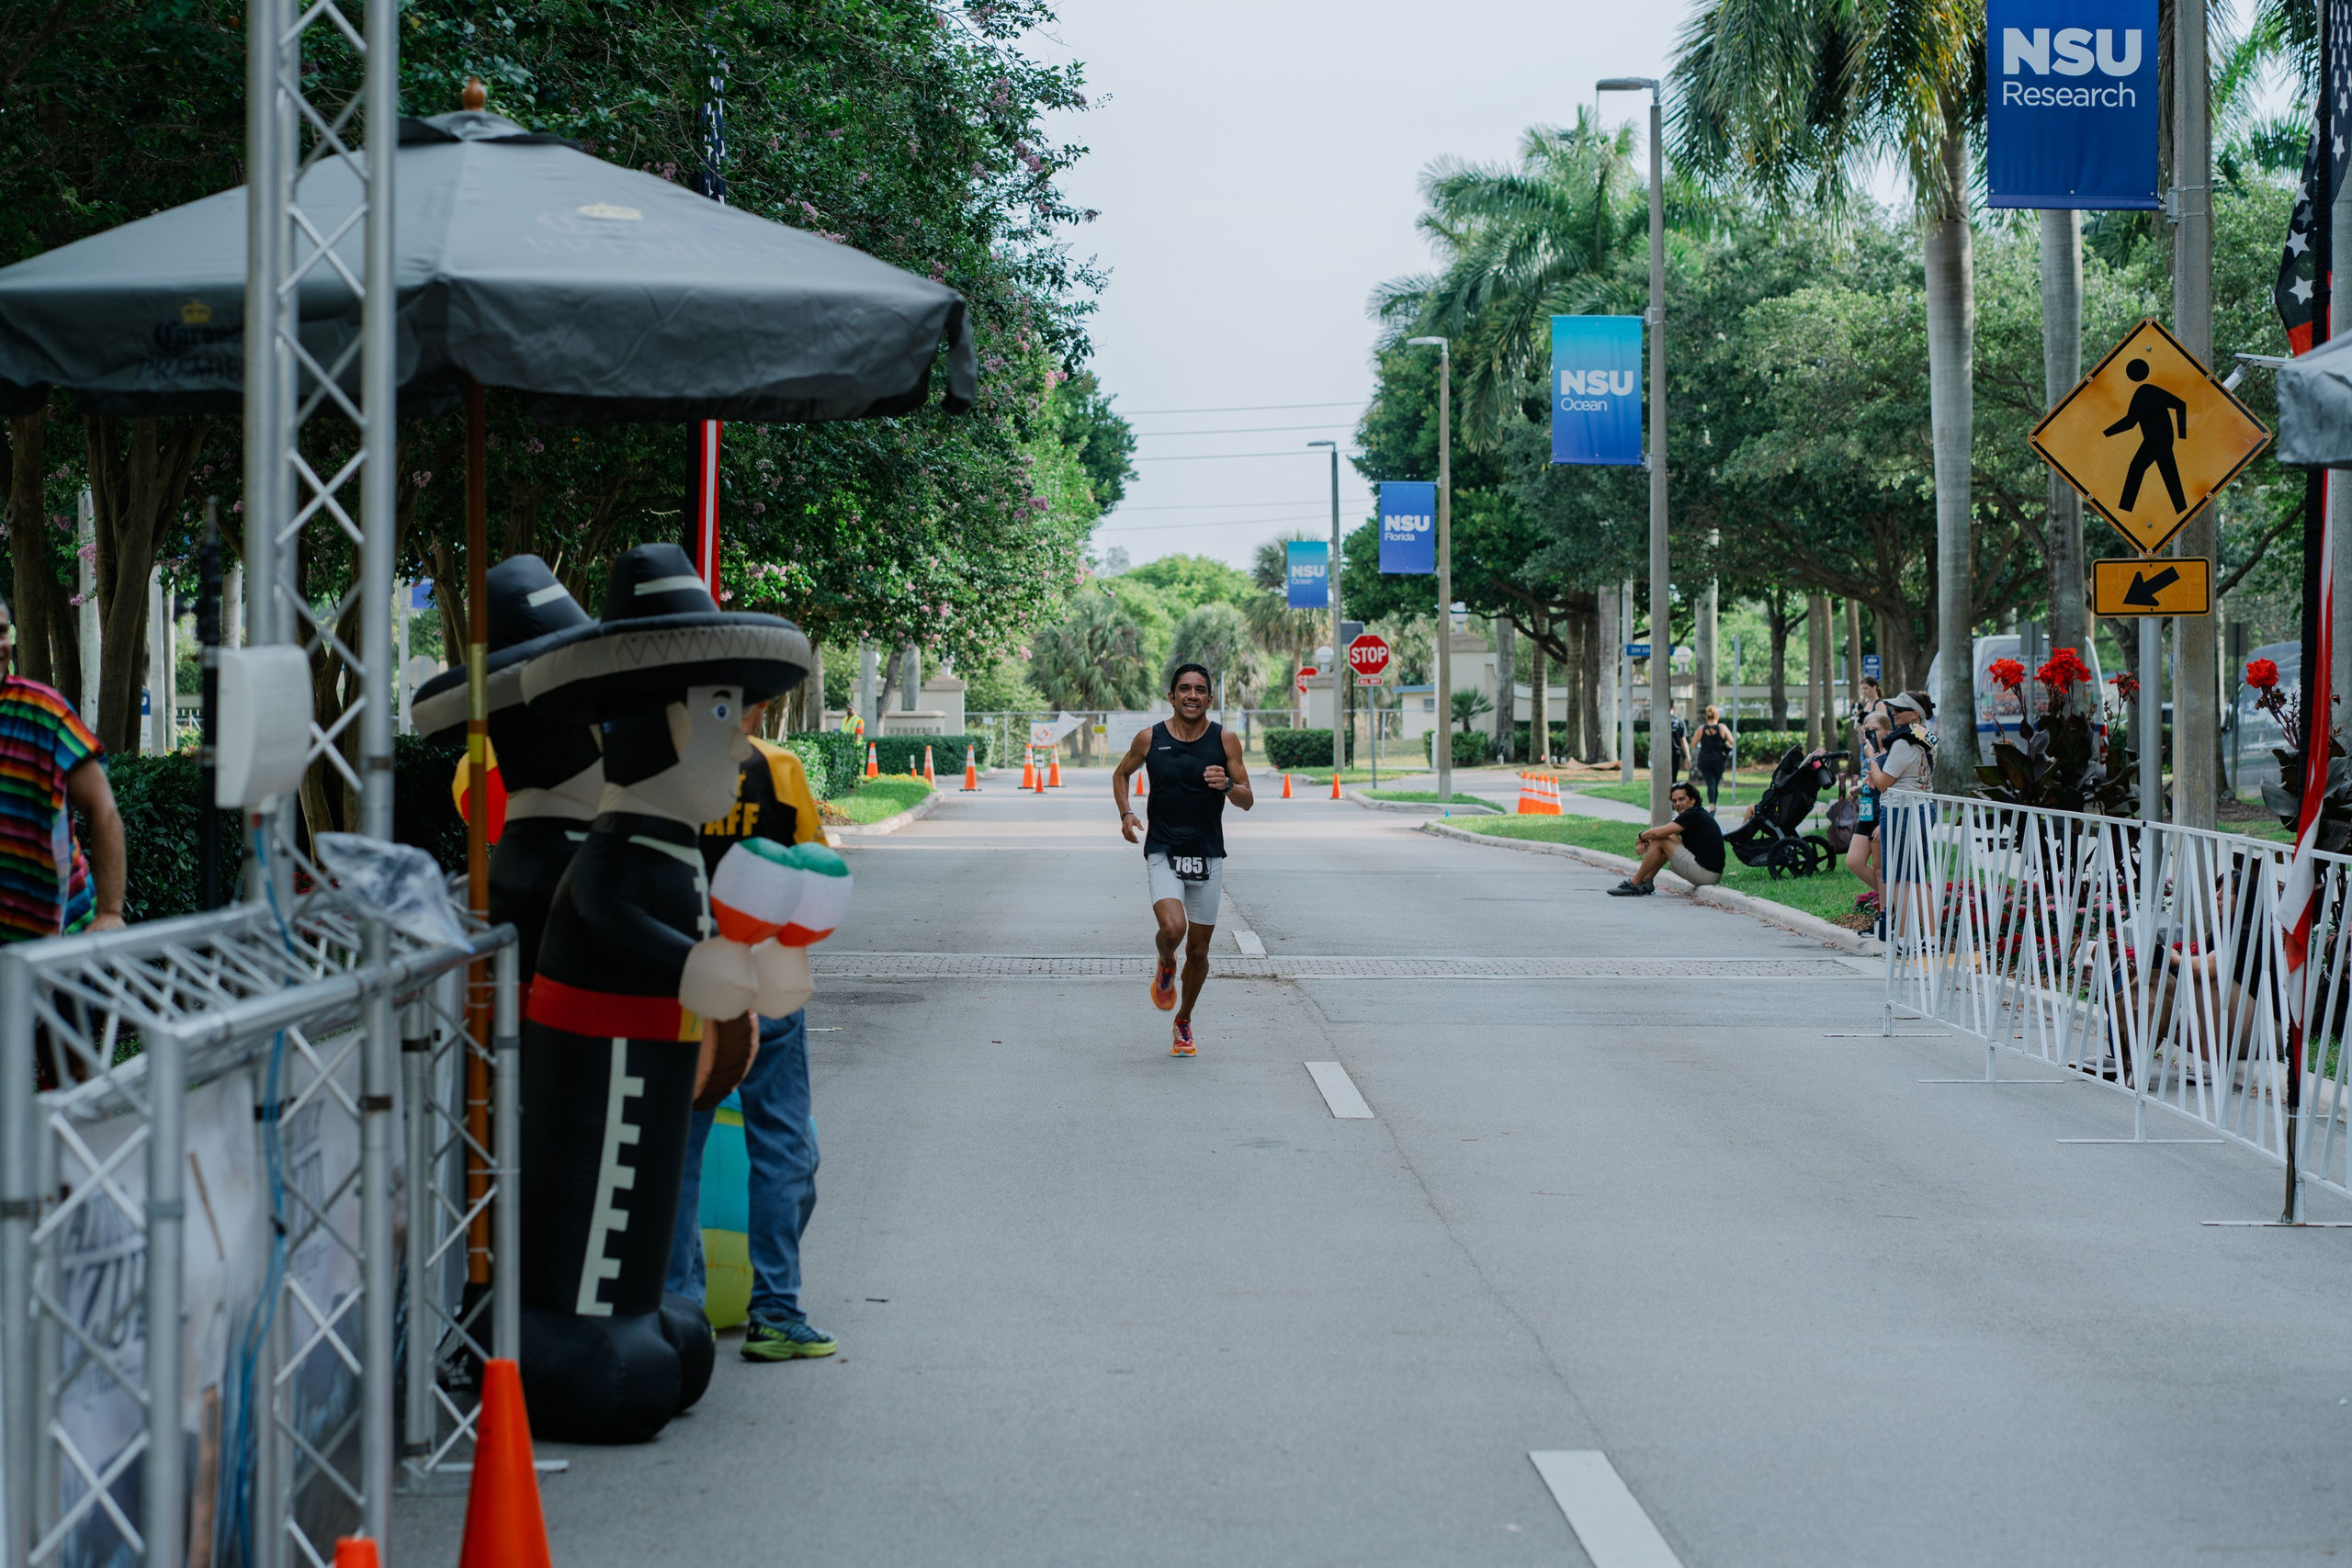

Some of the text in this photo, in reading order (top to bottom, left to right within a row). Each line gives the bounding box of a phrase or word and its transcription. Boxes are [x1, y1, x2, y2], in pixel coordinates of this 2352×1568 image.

[2003, 28, 2143, 76] NSU
[2003, 81, 2136, 107] Research
[1560, 369, 1634, 396] NSU
[1560, 397, 1608, 412] Ocean
[1385, 514, 1430, 532] NSU
[1385, 532, 1416, 541] Florida
[1291, 565, 1325, 578] NSU
[1351, 646, 1388, 663] STOP
[1172, 855, 1204, 874] 785
